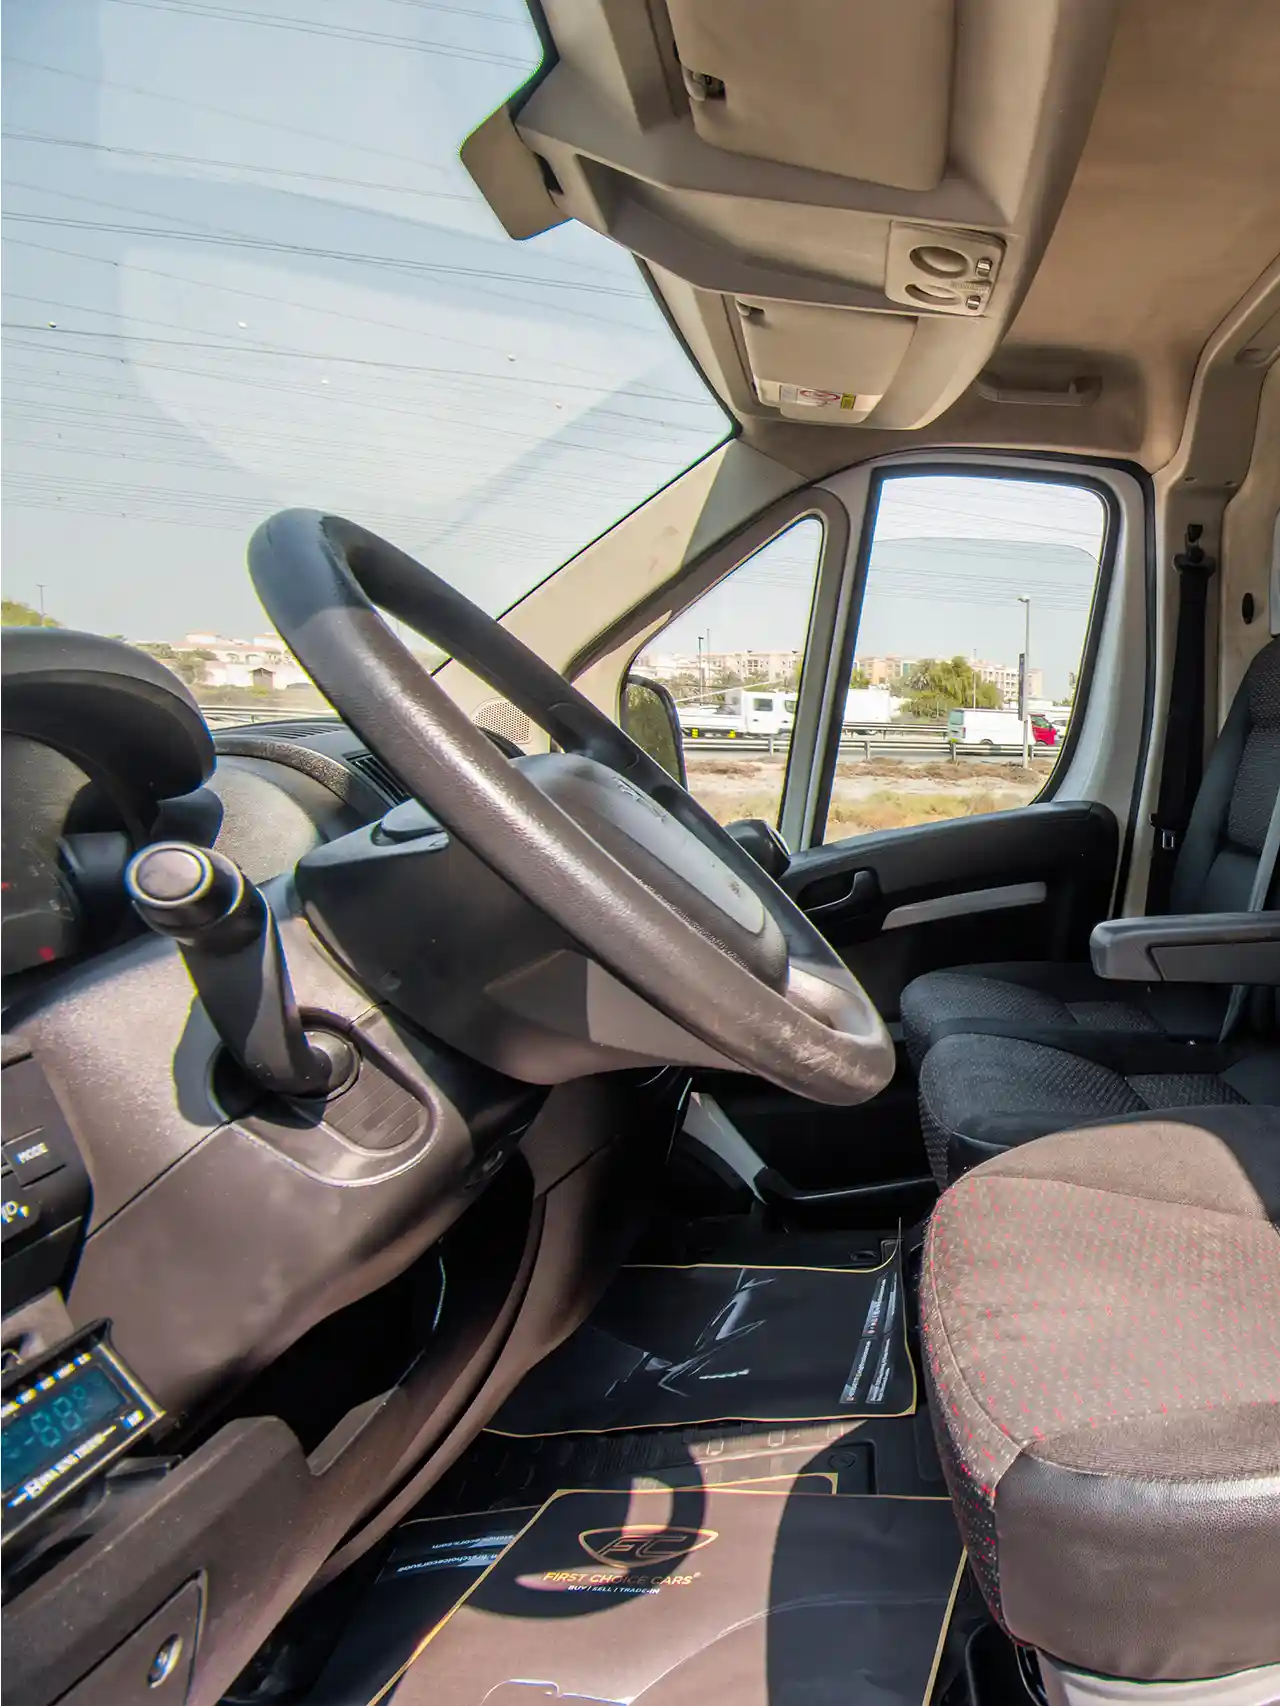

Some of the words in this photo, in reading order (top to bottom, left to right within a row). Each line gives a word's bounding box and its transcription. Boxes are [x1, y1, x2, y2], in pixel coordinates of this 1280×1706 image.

[16, 1142, 48, 1164] MODE
[542, 1571, 589, 1583] FIRST
[589, 1573, 649, 1585] CHOICE
[650, 1574, 694, 1585] CARS
[567, 1584, 586, 1592] BUY
[618, 1586, 661, 1595] TRADE-IN
